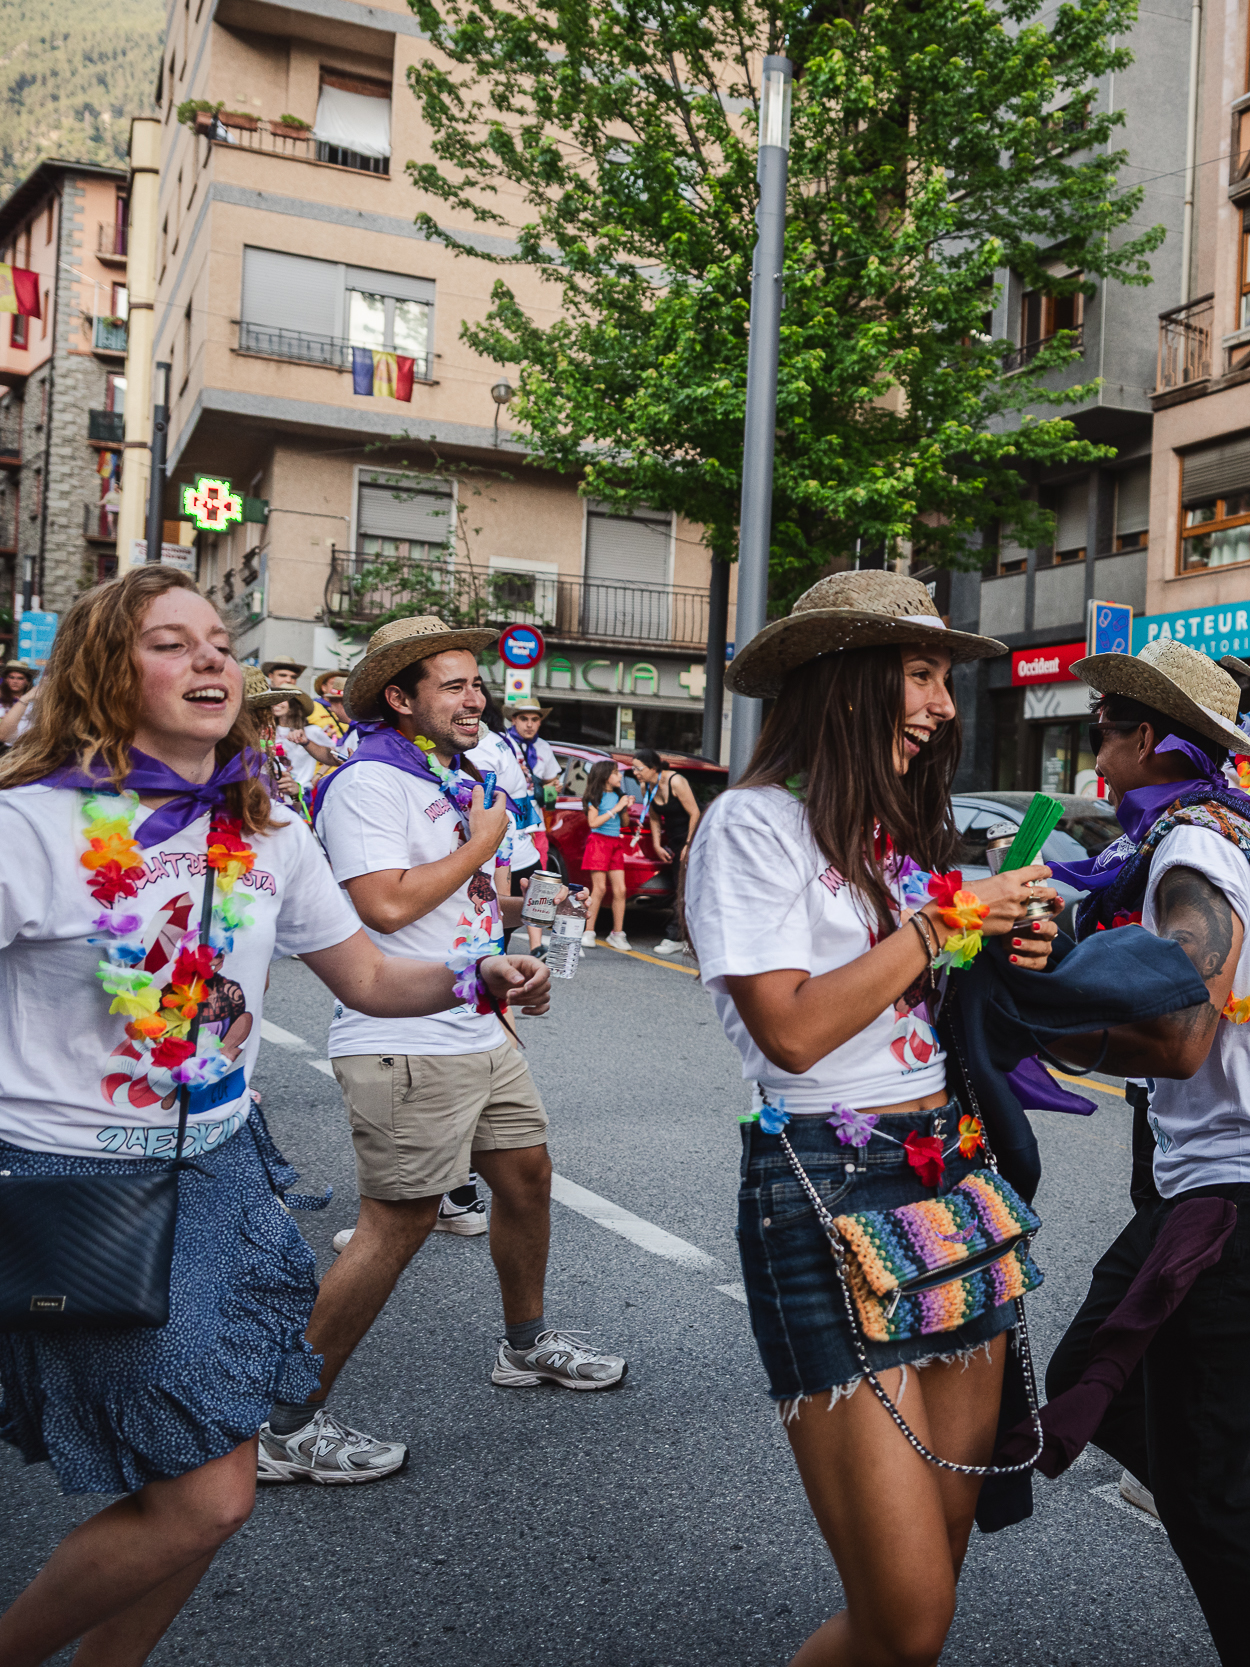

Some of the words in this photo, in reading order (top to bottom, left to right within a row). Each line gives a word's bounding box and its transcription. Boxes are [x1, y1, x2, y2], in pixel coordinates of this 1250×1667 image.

[1148, 610, 1249, 642] PASTEUR
[1018, 657, 1060, 677] Occident
[546, 1352, 568, 1369] N
[309, 1438, 337, 1457] N
